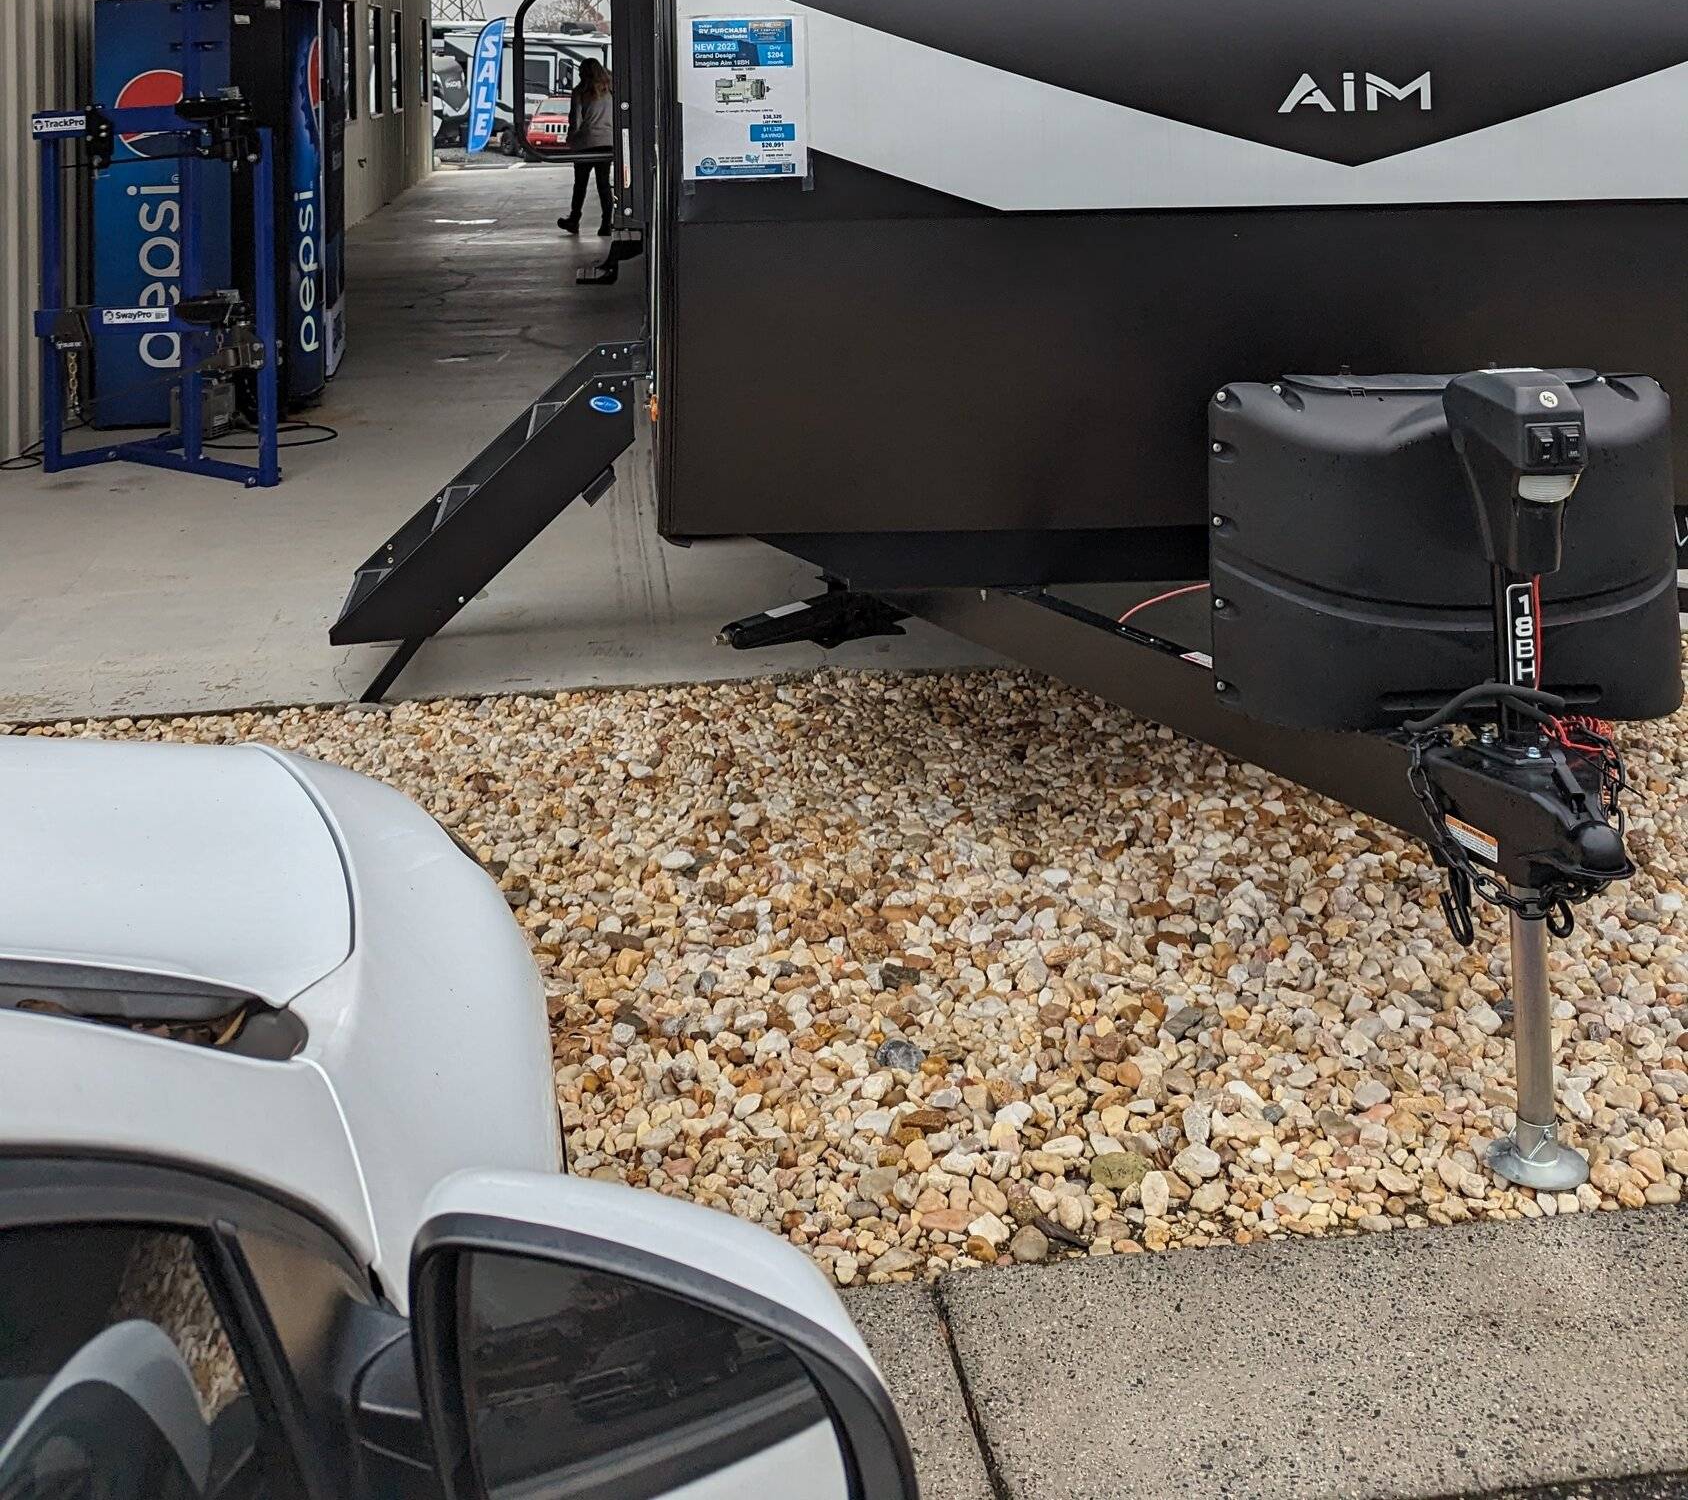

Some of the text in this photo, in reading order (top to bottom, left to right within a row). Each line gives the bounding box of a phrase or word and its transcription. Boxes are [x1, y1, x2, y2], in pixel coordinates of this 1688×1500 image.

[694, 43, 737, 51] NEW 2023
[474, 35, 500, 136] SALE
[44, 118, 85, 129] TrackPro
[294, 190, 320, 353] pepsi
[115, 311, 152, 320] SwayPro
[1515, 593, 1536, 681] 18BH
